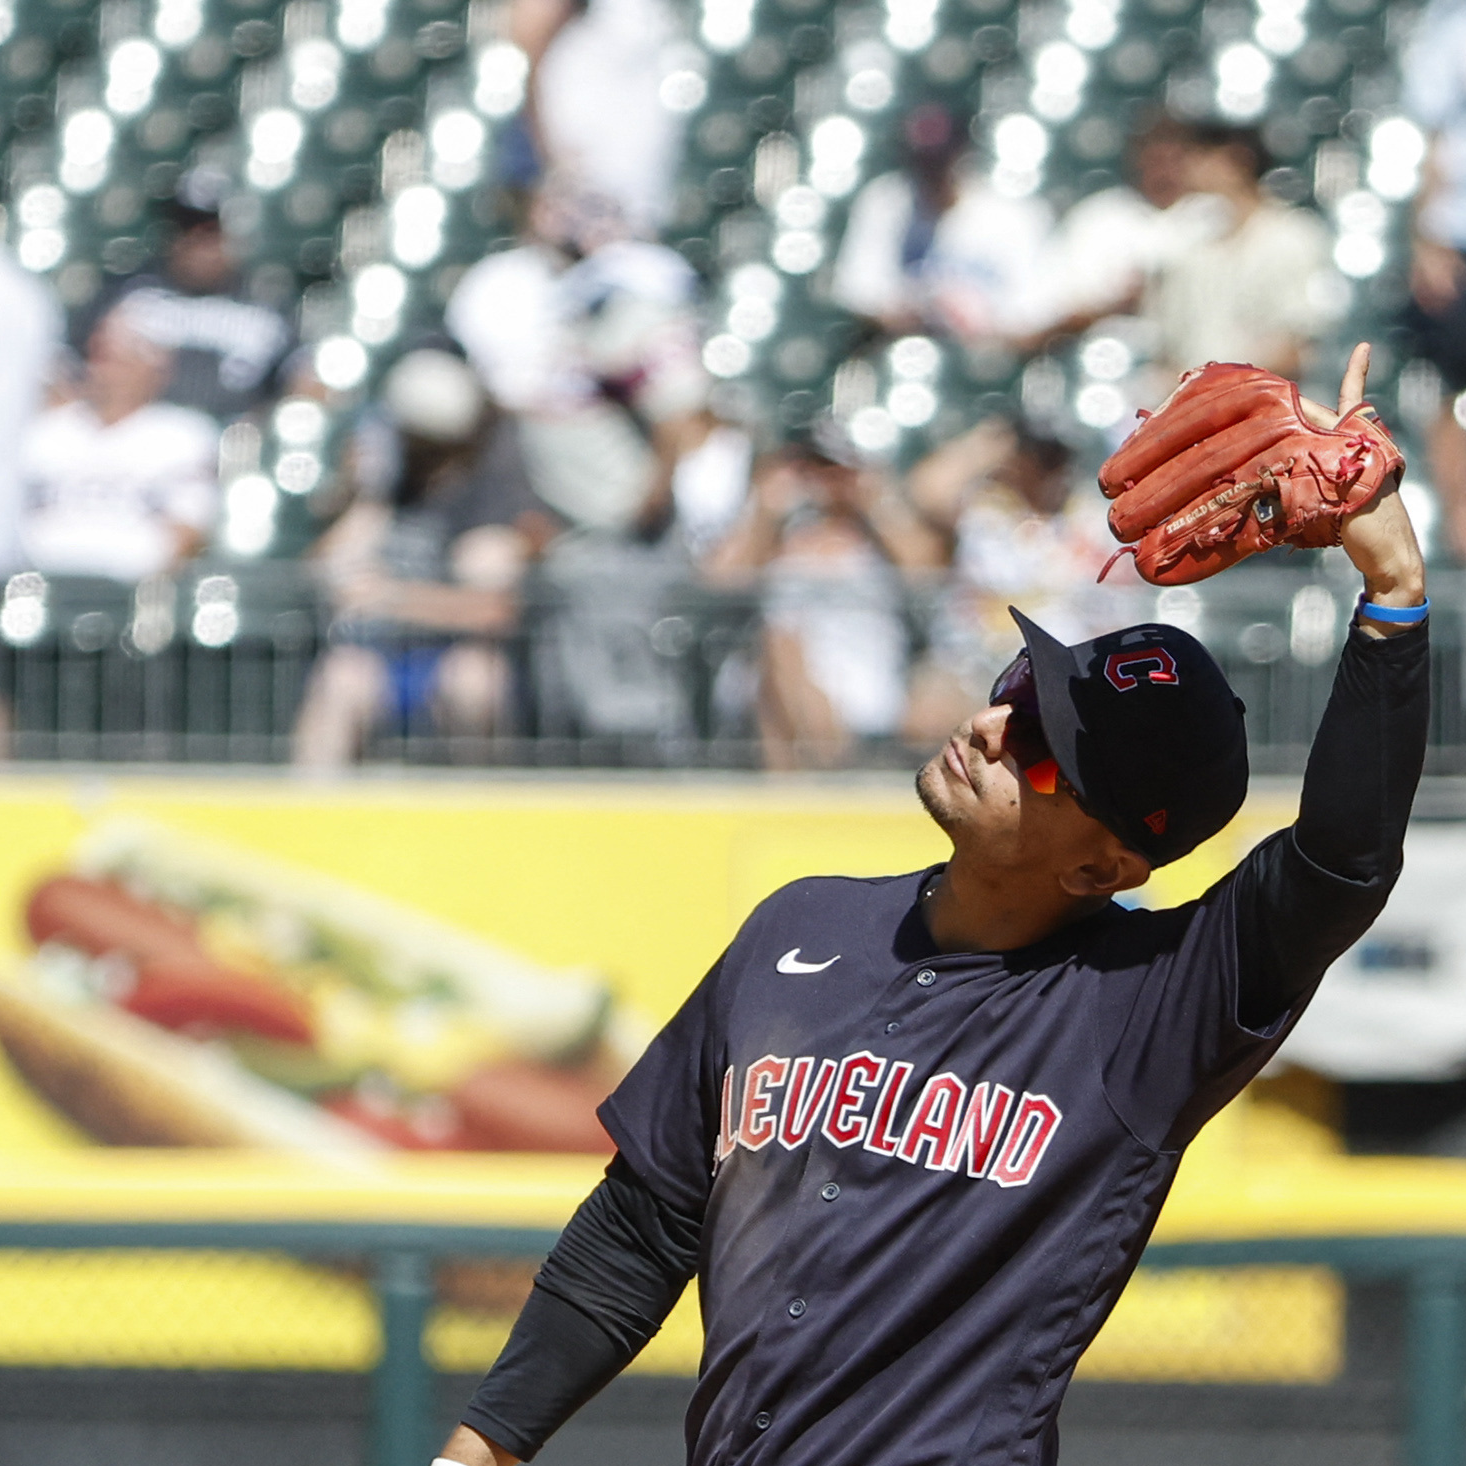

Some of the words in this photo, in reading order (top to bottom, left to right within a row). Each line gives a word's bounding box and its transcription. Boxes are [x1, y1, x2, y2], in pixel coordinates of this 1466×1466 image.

[1185, 503, 1210, 525] GOLD
[1104, 646, 1179, 693] C
[713, 1050, 1063, 1188] LEVELAND
